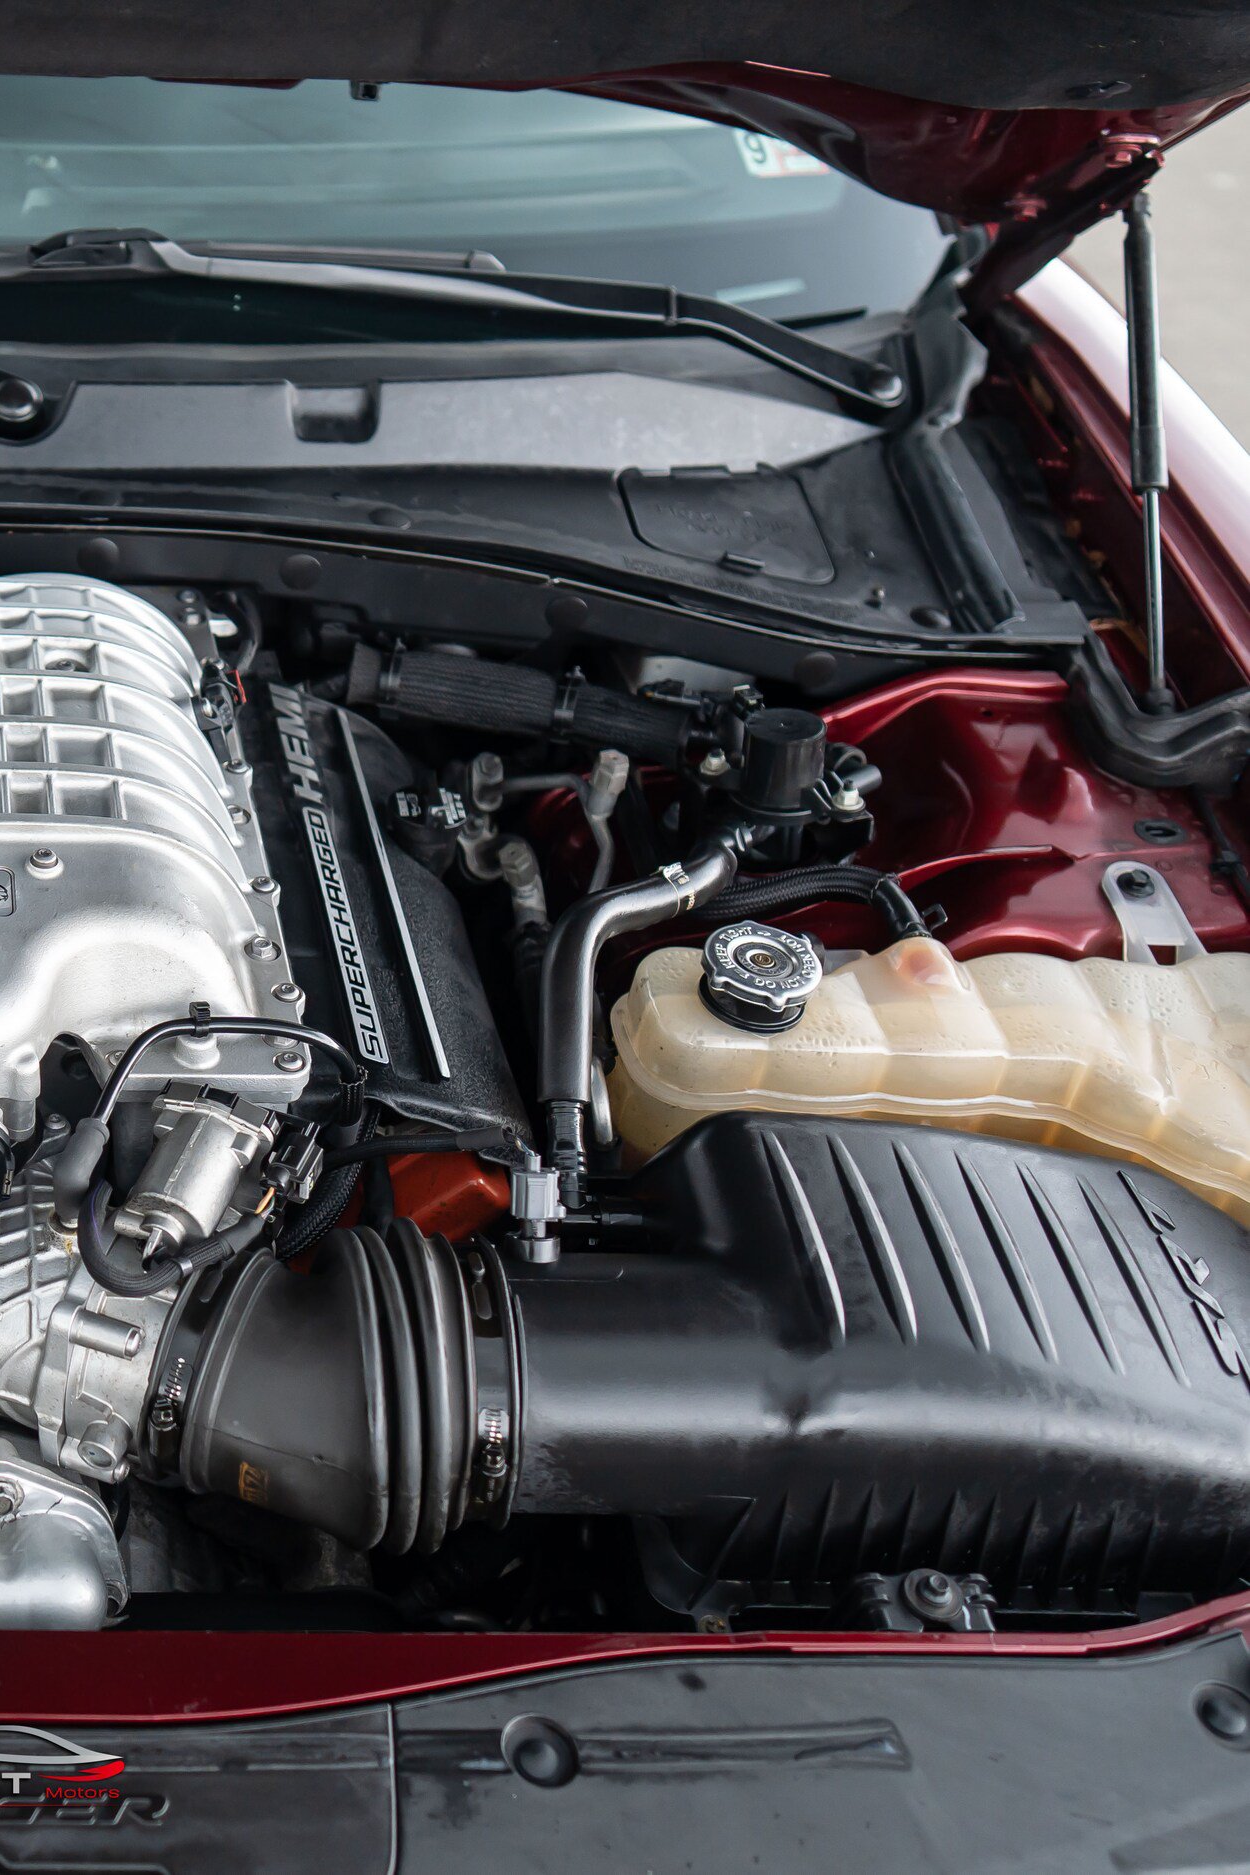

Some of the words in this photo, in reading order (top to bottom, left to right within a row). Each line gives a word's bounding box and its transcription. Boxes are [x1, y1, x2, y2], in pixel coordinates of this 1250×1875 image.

[268, 682, 324, 805] HEMI
[307, 810, 385, 1060] SUPERCHARGED
[715, 943, 736, 969] KEEP
[719, 926, 753, 942] TIGHT
[754, 977, 777, 989] DO
[1116, 1169, 1250, 1395] SRT
